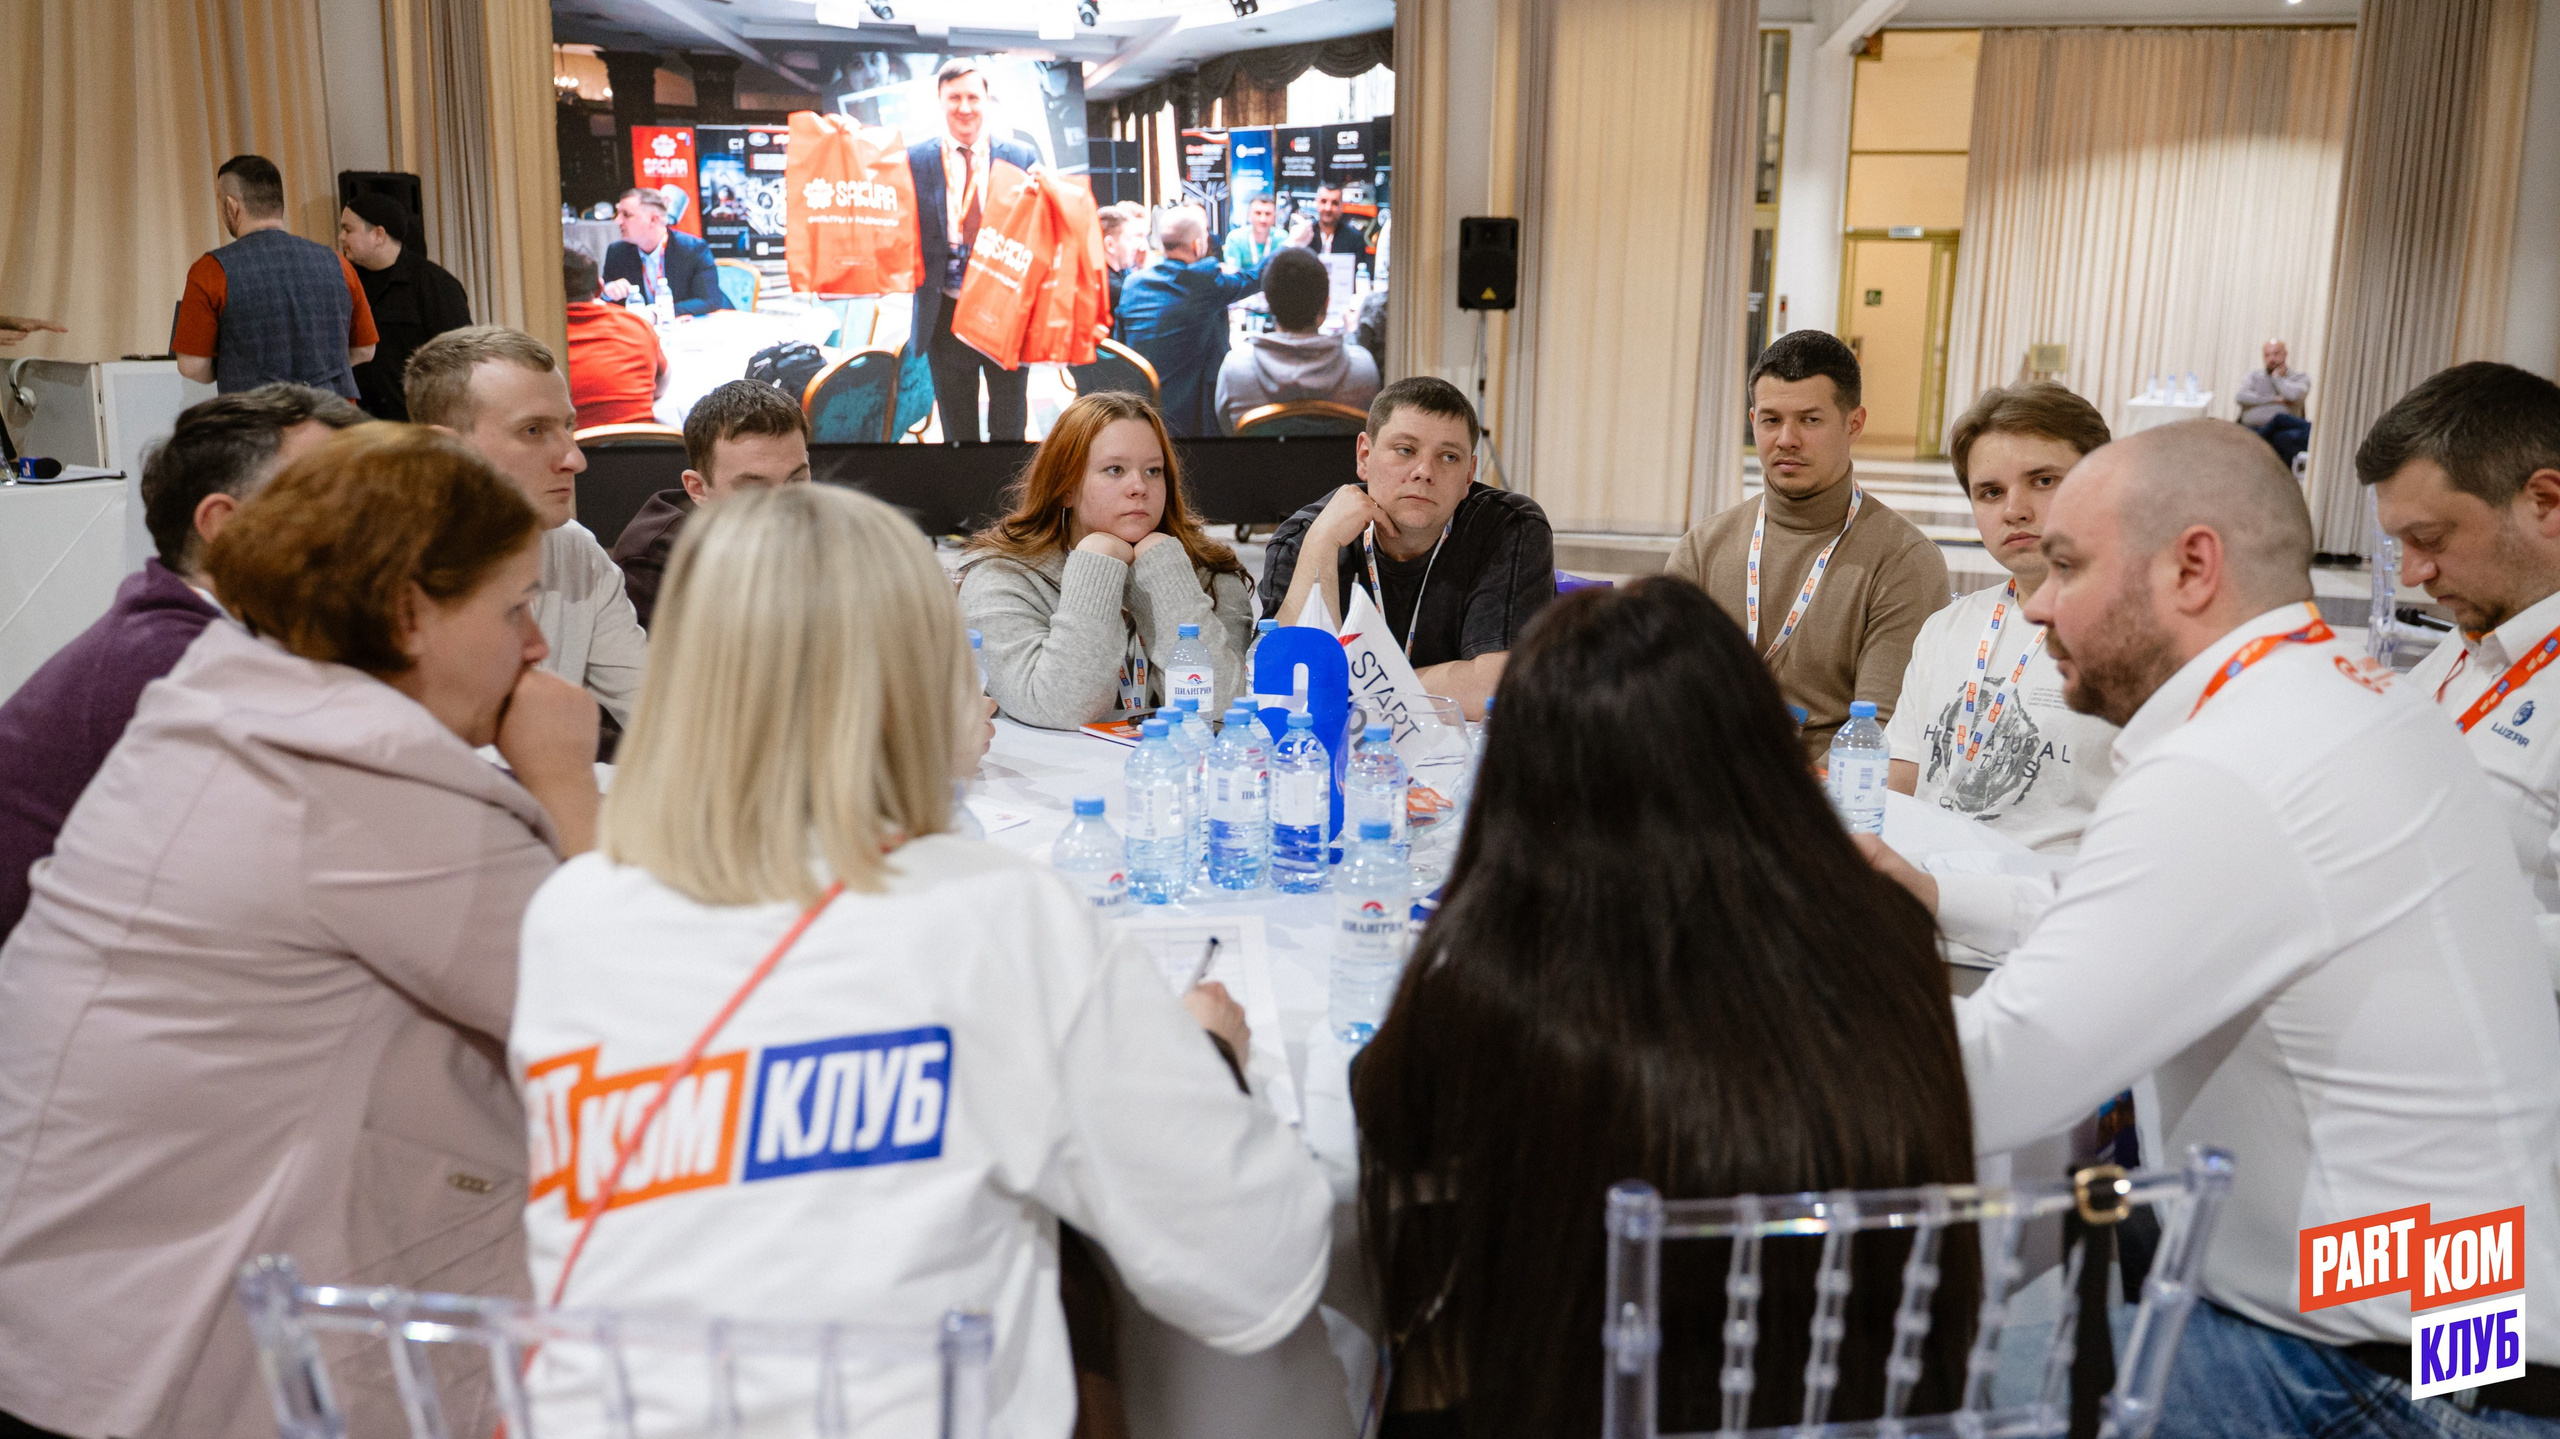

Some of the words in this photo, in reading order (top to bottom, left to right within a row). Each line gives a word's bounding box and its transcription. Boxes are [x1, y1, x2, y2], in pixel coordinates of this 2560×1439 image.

[835, 180, 898, 211] SAKURA
[1351, 651, 1421, 744] START
[756, 1040, 948, 1163] КЛУБ
